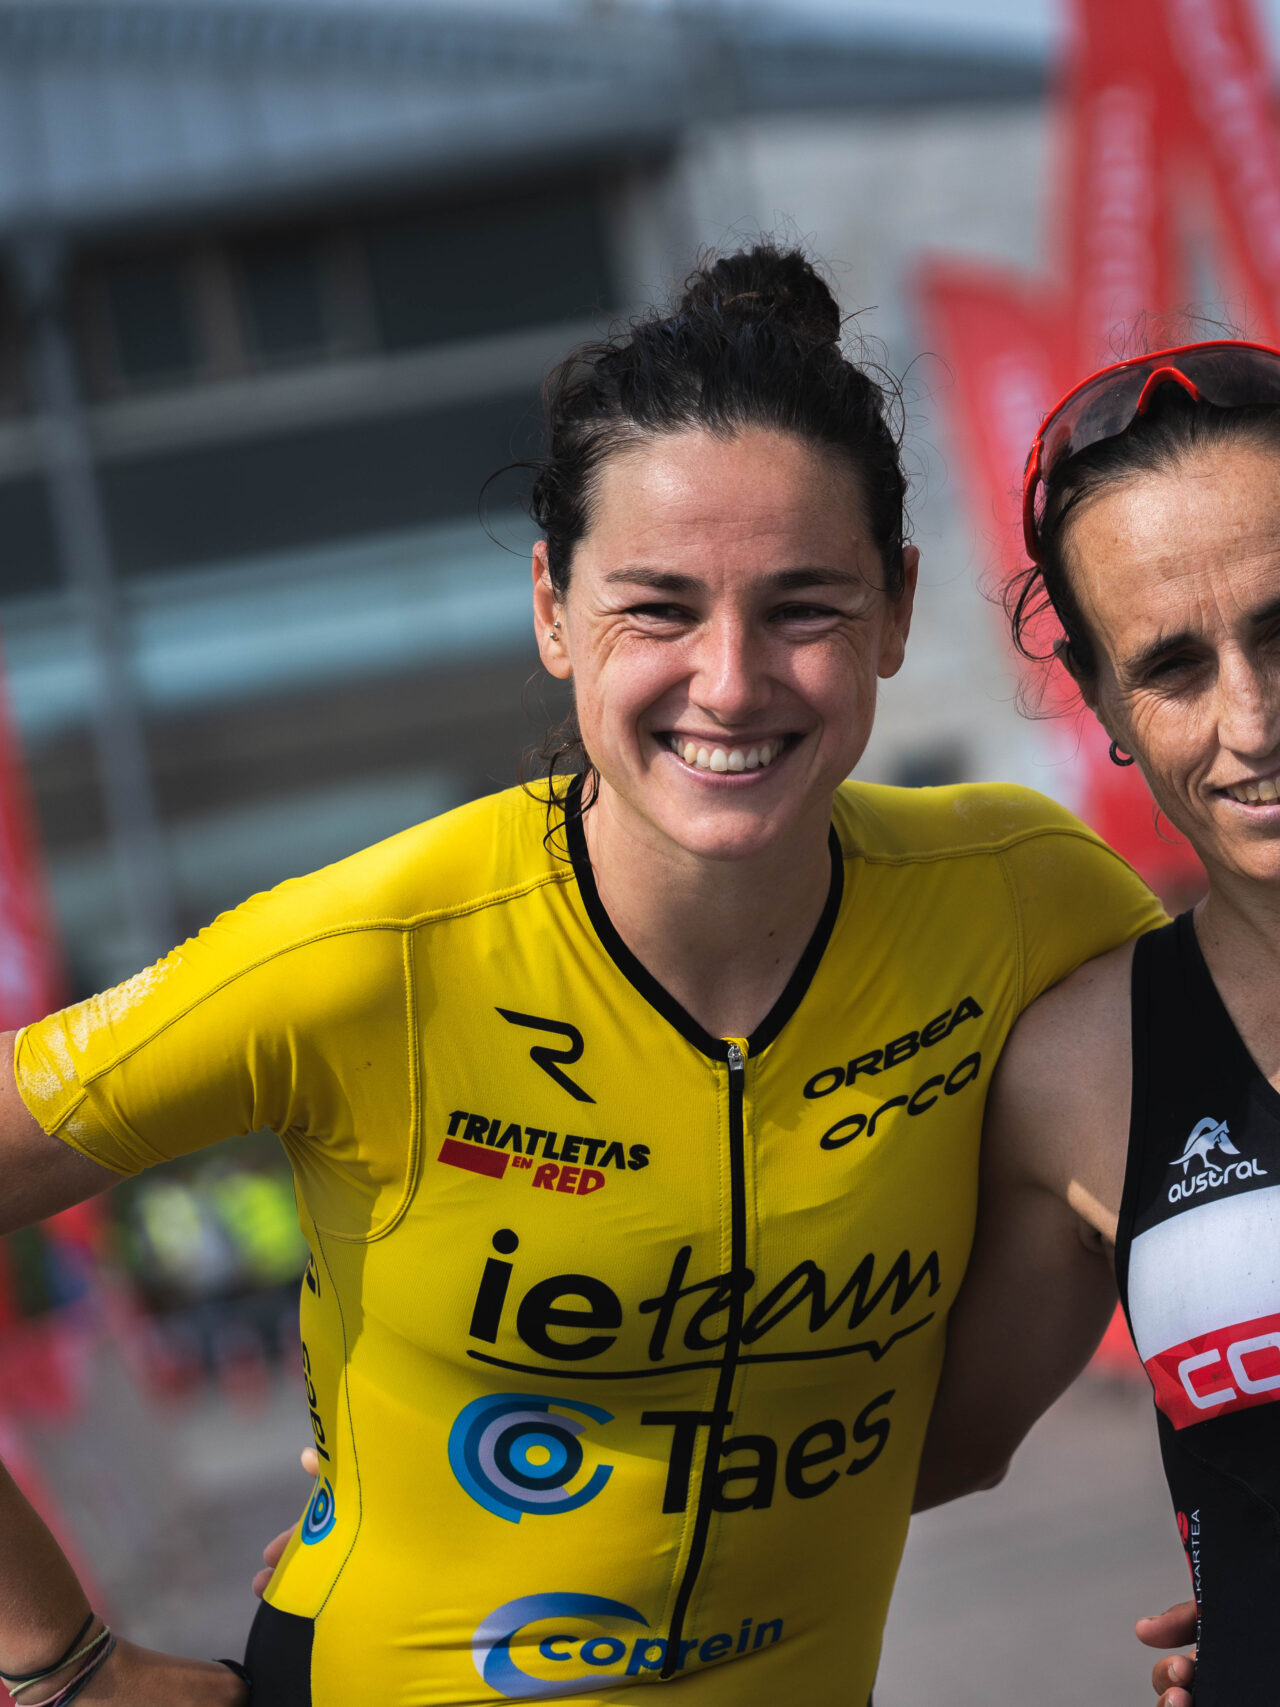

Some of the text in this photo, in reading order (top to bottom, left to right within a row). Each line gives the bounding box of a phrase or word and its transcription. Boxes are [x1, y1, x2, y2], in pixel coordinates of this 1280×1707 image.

[803, 996, 984, 1099] ORBEA
[819, 1052, 981, 1151] orca
[446, 1110, 650, 1171] TRIATLETAS
[511, 1157, 606, 1196] EN RED
[1168, 1157, 1268, 1203] austral
[640, 1389, 896, 1515] Taes
[537, 1617, 785, 1674] coprein
